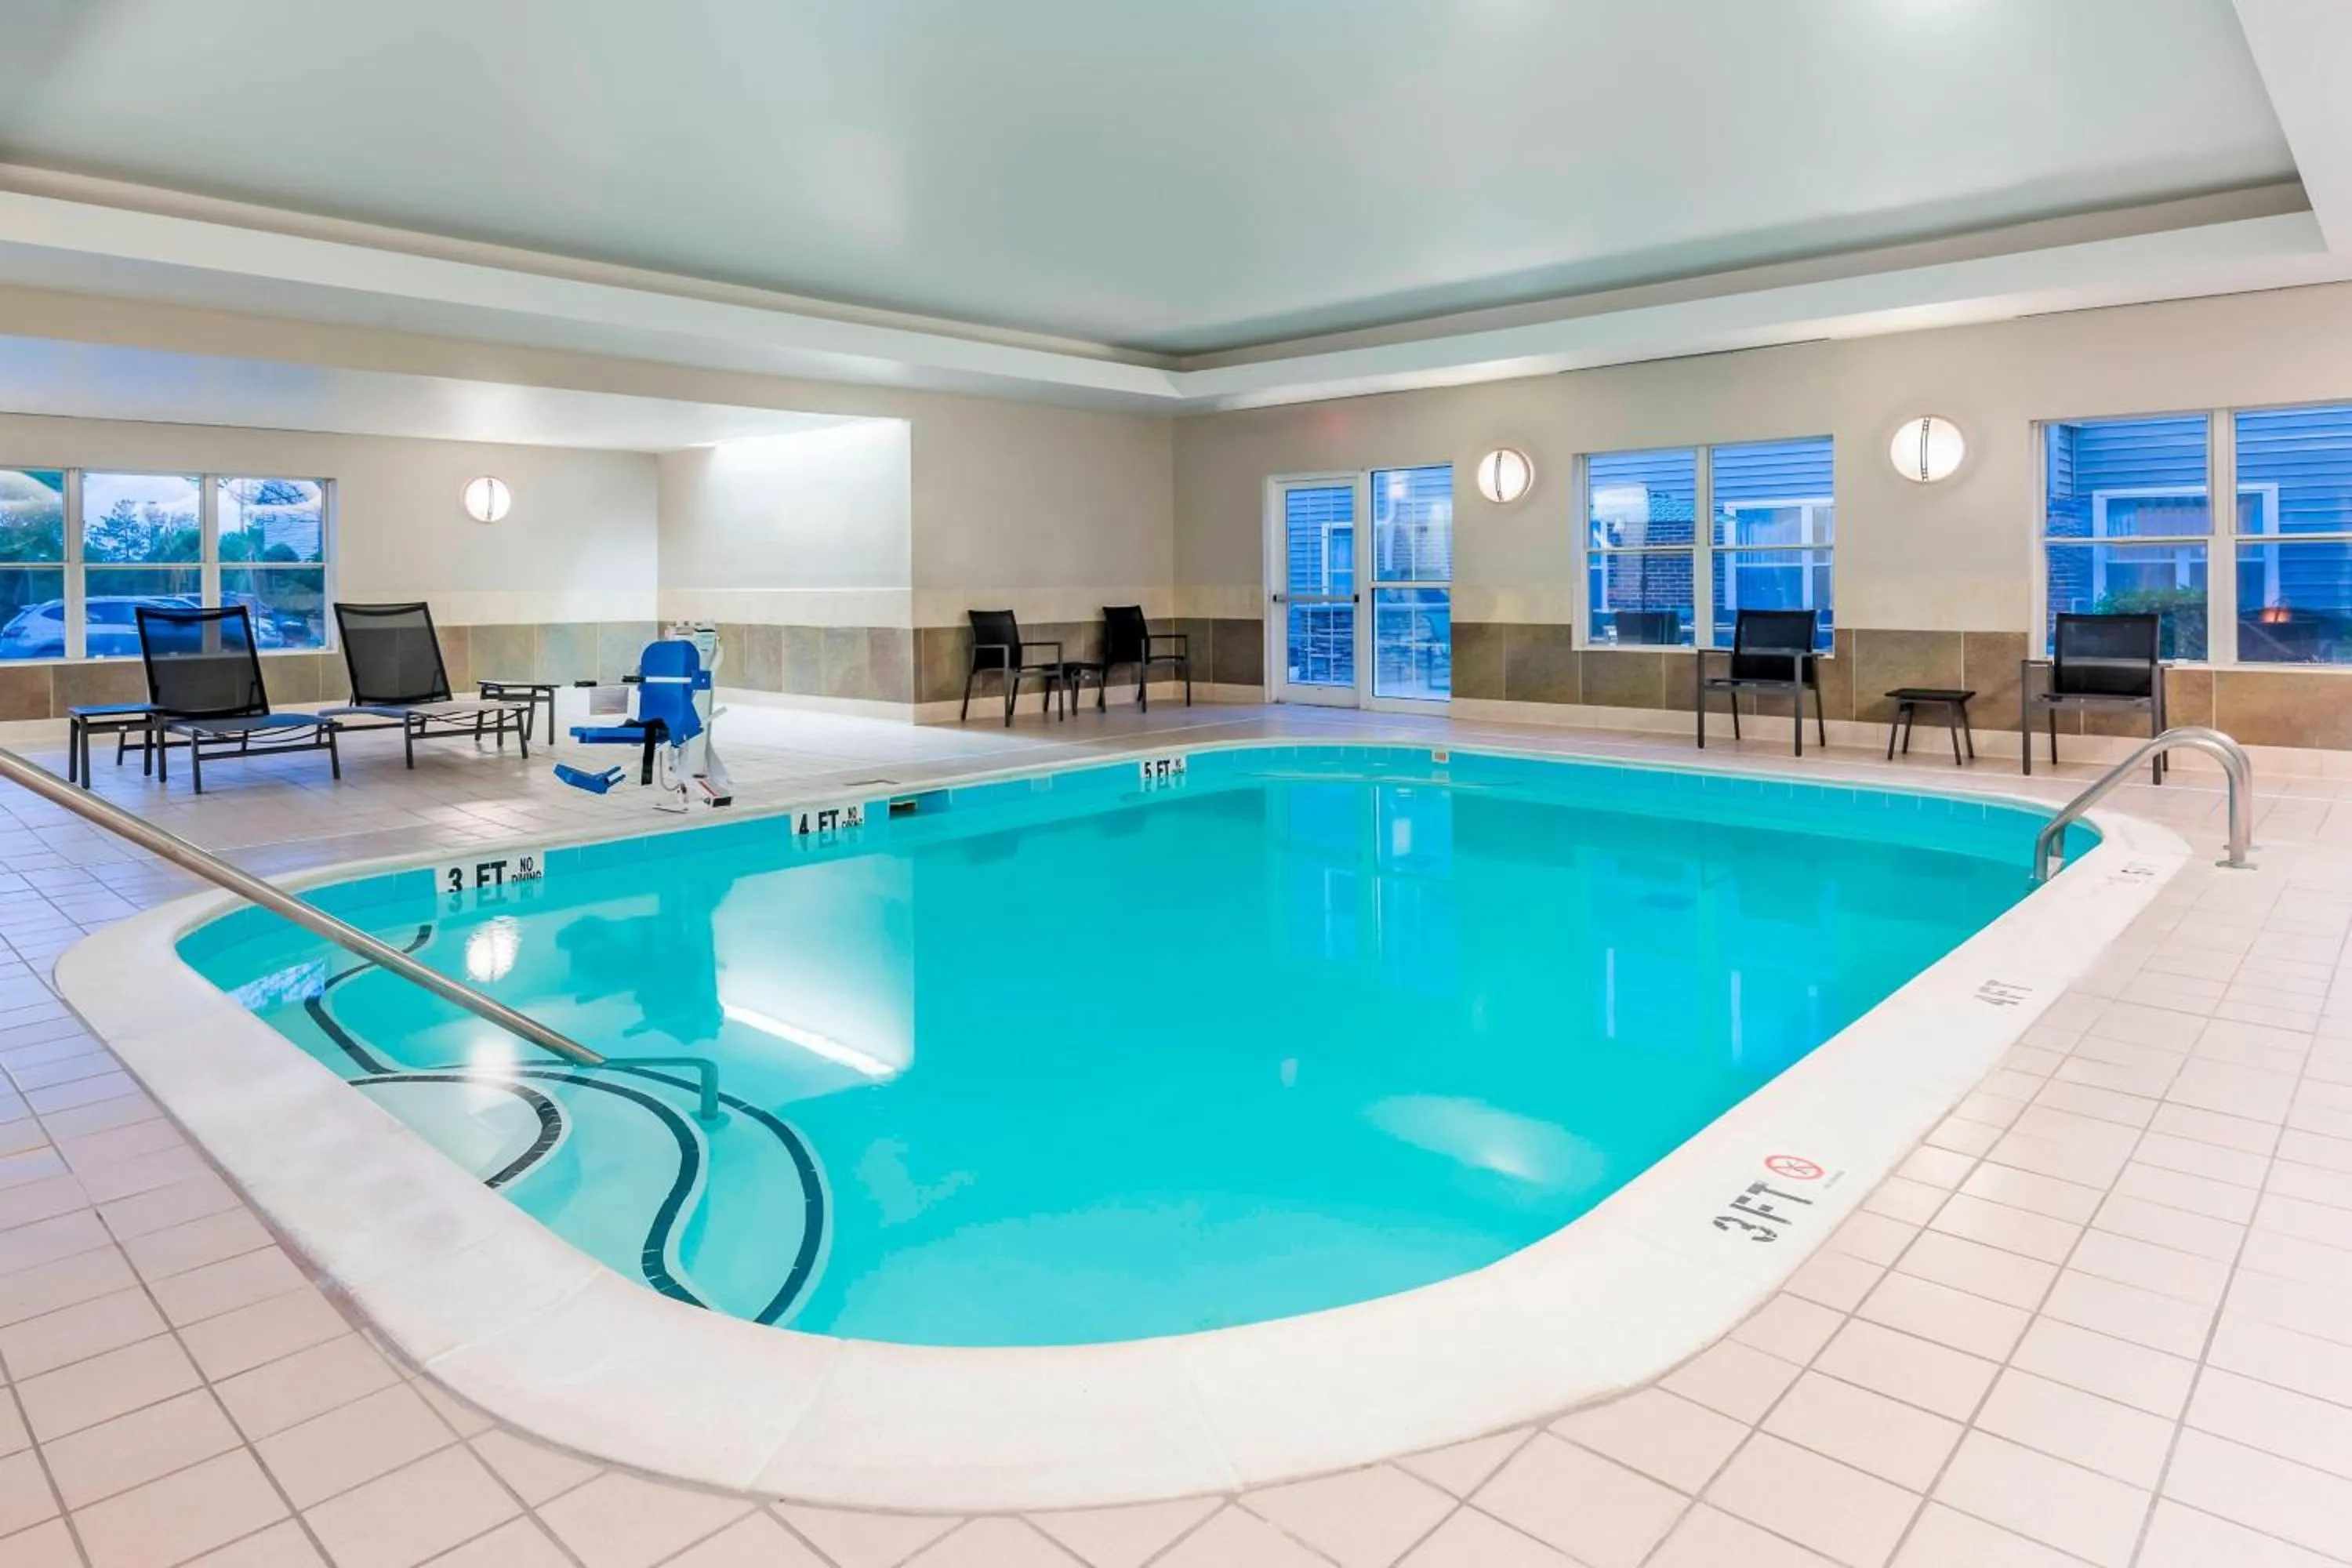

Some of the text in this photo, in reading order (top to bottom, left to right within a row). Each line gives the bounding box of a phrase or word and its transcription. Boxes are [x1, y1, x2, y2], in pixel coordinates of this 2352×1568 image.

[1144, 761, 1152, 779] 5
[1156, 760, 1171, 777] FT
[798, 813, 809, 834] 4
[818, 809, 840, 832] FT
[448, 860, 507, 892] 3 FT
[520, 857, 534, 873] NO
